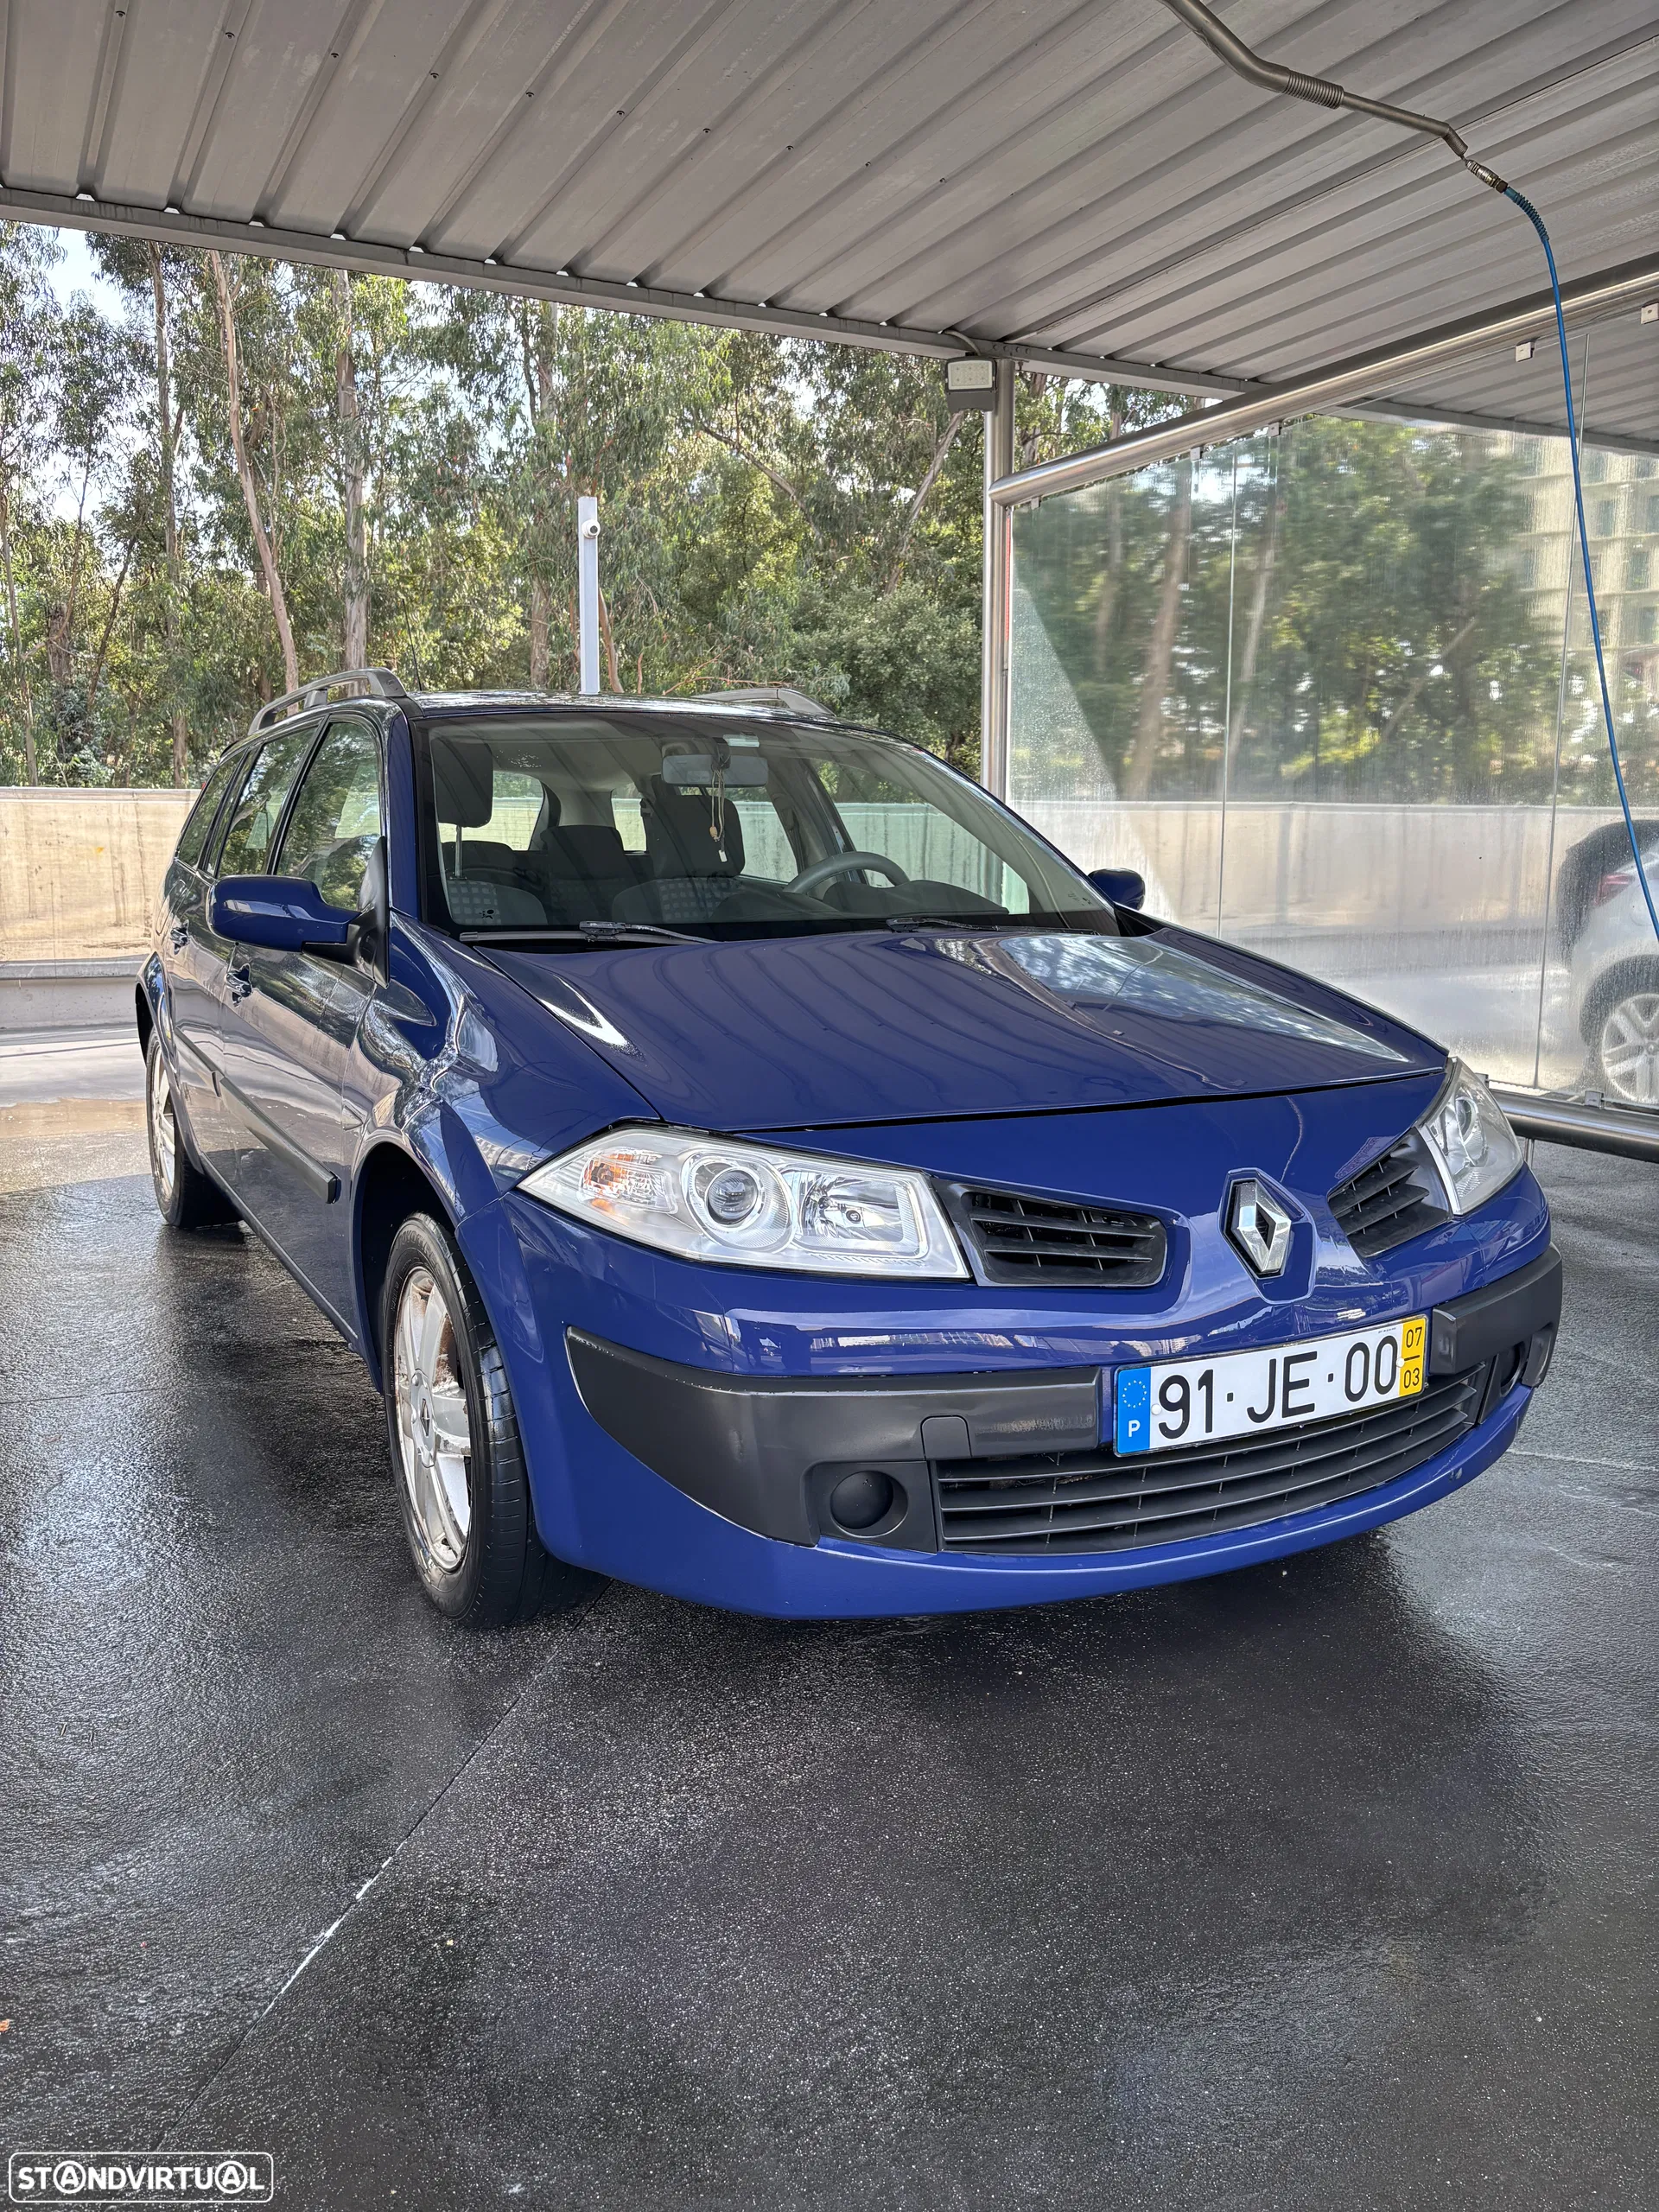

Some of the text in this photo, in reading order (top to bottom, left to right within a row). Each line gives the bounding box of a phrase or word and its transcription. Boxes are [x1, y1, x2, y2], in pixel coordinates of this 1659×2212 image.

[1406, 1326, 1422, 1348] 07
[1403, 1370, 1421, 1389] 03
[1128, 1421, 1141, 1437] P
